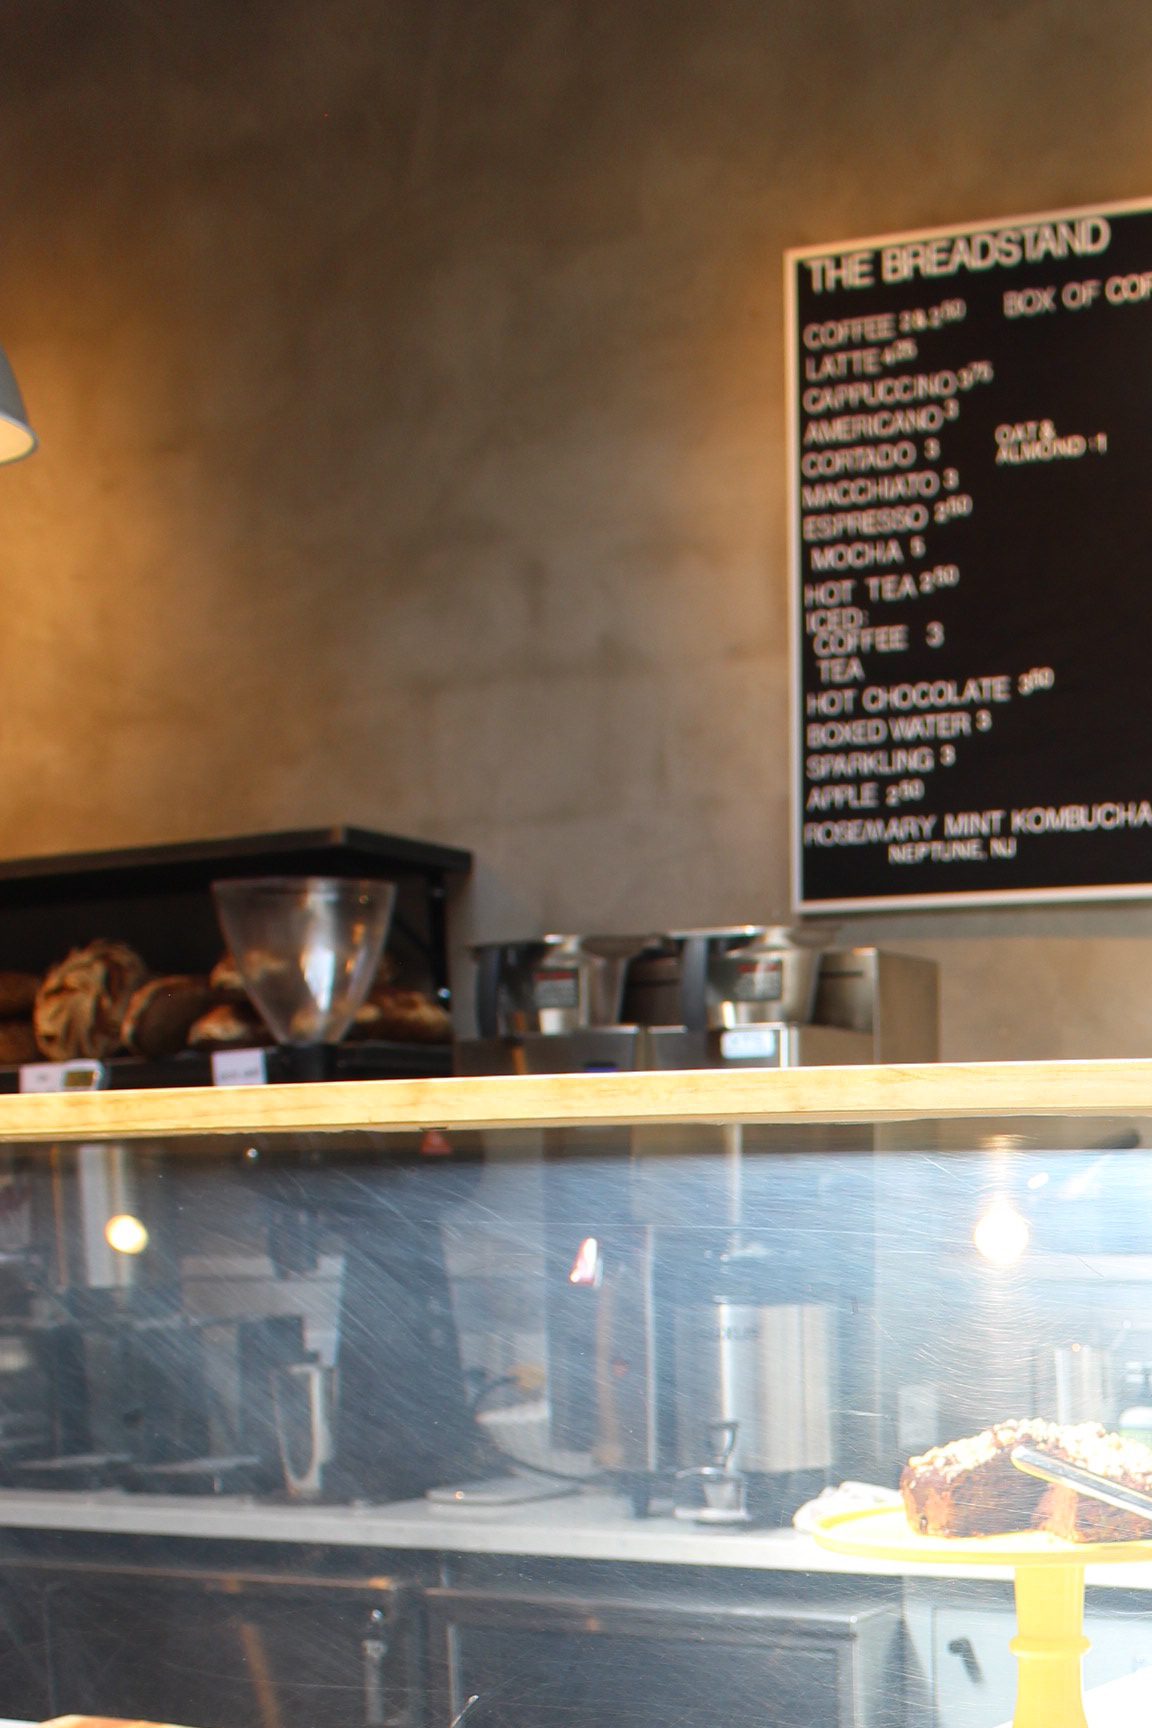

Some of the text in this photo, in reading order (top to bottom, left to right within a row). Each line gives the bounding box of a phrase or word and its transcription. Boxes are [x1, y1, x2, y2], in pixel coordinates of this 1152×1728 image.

[803, 216, 1111, 294] THE BREADSTAND
[1003, 285, 1057, 319] BOX
[1062, 280, 1100, 309] OF
[803, 312, 897, 350] COFFEE
[805, 346, 882, 382] LATTE
[802, 370, 958, 415] CAPPUCCINO
[803, 398, 959, 445] AMERICANO 3
[802, 437, 941, 479] CORTADO 3
[995, 434, 1087, 466] ALMOND
[802, 467, 960, 510] MACCHIATO 3
[802, 503, 929, 542] ESPRESSO
[811, 538, 905, 571] MOCHA
[804, 580, 856, 608] HOT
[865, 573, 919, 603] TEA
[813, 621, 944, 657] COFFEE 3
[816, 657, 865, 684] TEA
[807, 688, 857, 717] HOT
[862, 675, 1011, 713] CHOCOLATE
[807, 709, 992, 749] BOXED WATER 3
[805, 745, 956, 780] SPARKLING 3
[807, 781, 878, 811] APPLE
[804, 815, 937, 848] ROSEMARY
[943, 810, 1006, 839] MINT
[990, 837, 1017, 859] NJ
